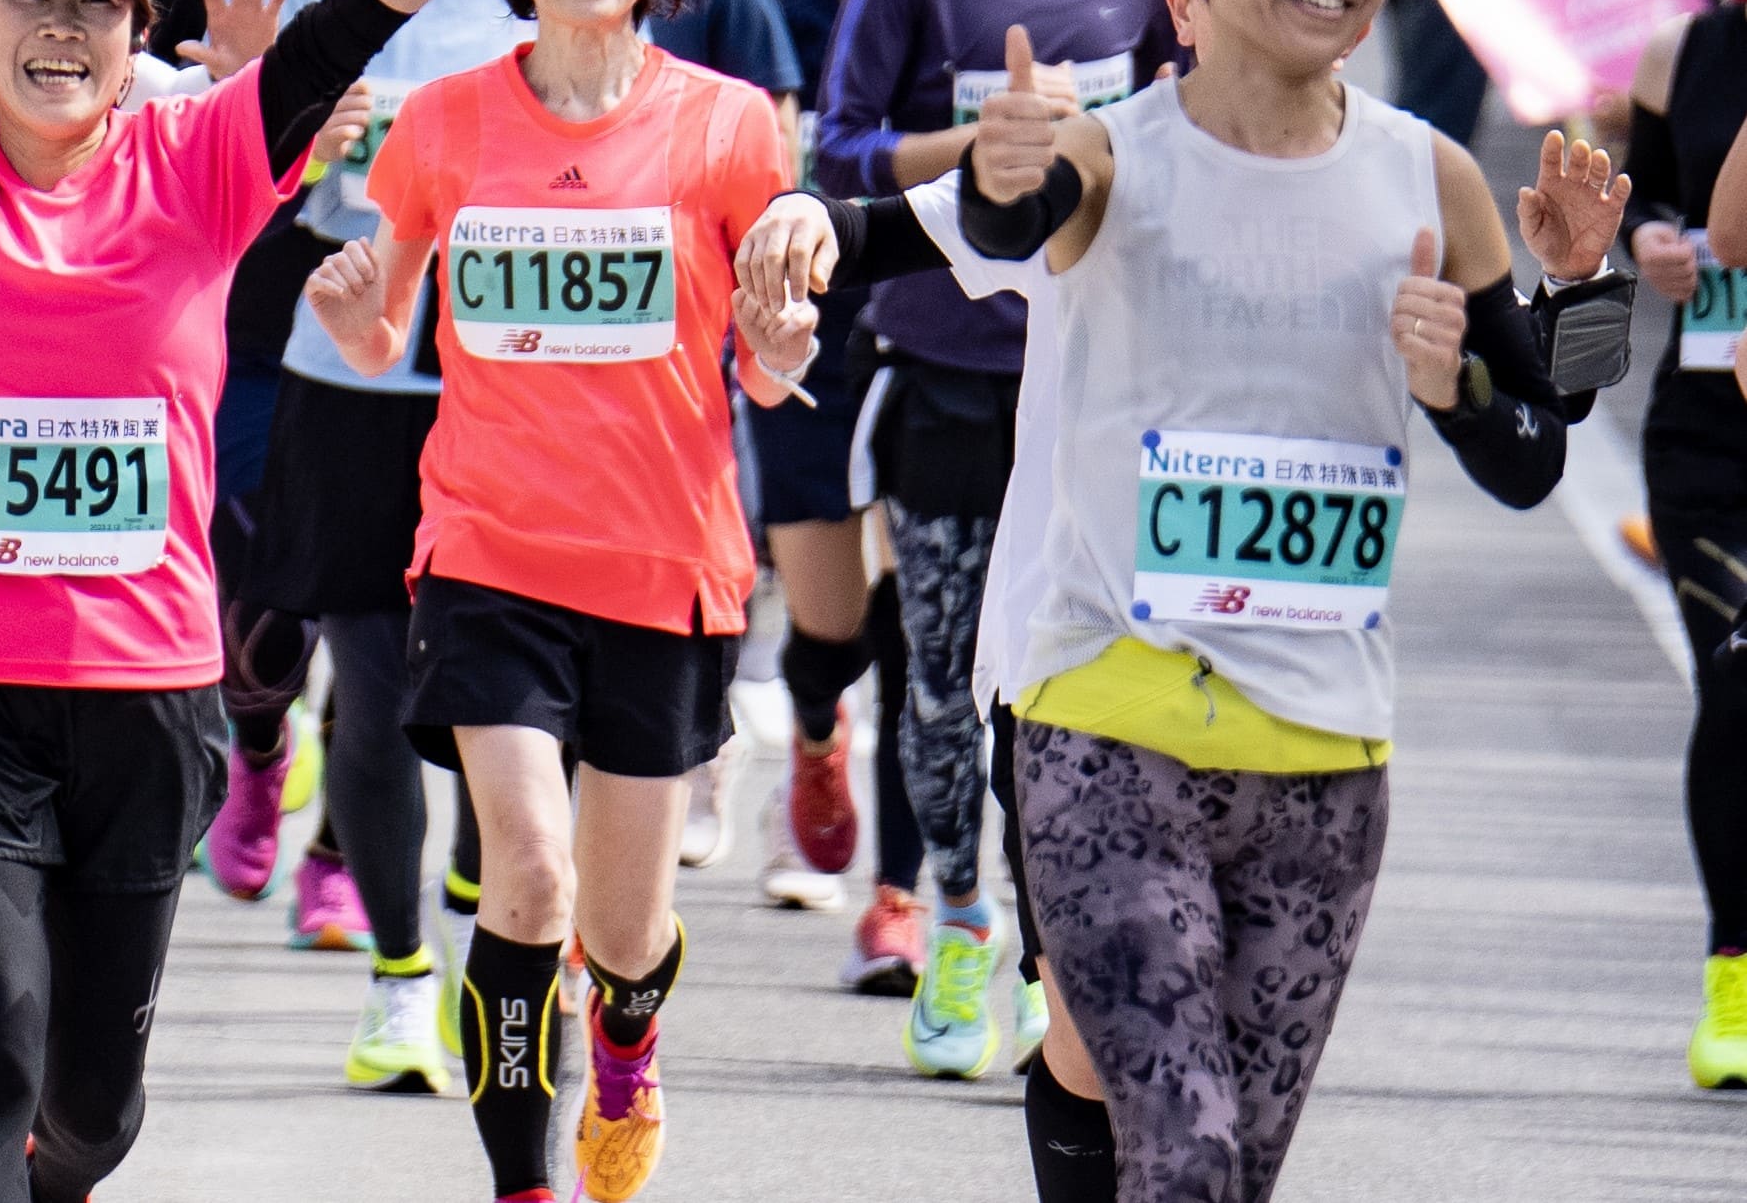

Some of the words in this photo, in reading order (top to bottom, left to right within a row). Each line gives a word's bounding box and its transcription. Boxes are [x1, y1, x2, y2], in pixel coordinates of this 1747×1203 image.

[454, 220, 545, 243] Niterra
[457, 249, 663, 312] C11857
[544, 344, 571, 354] new
[575, 342, 631, 355] balance
[37, 418, 159, 439] 日本特殊陶業
[1148, 448, 1265, 478] Niterra
[1149, 482, 1389, 570] C12878
[23, 556, 53, 566] new
[58, 553, 119, 567] balance
[1251, 605, 1282, 619] new
[1286, 605, 1342, 622] balance
[498, 997, 529, 1089] SKINS
